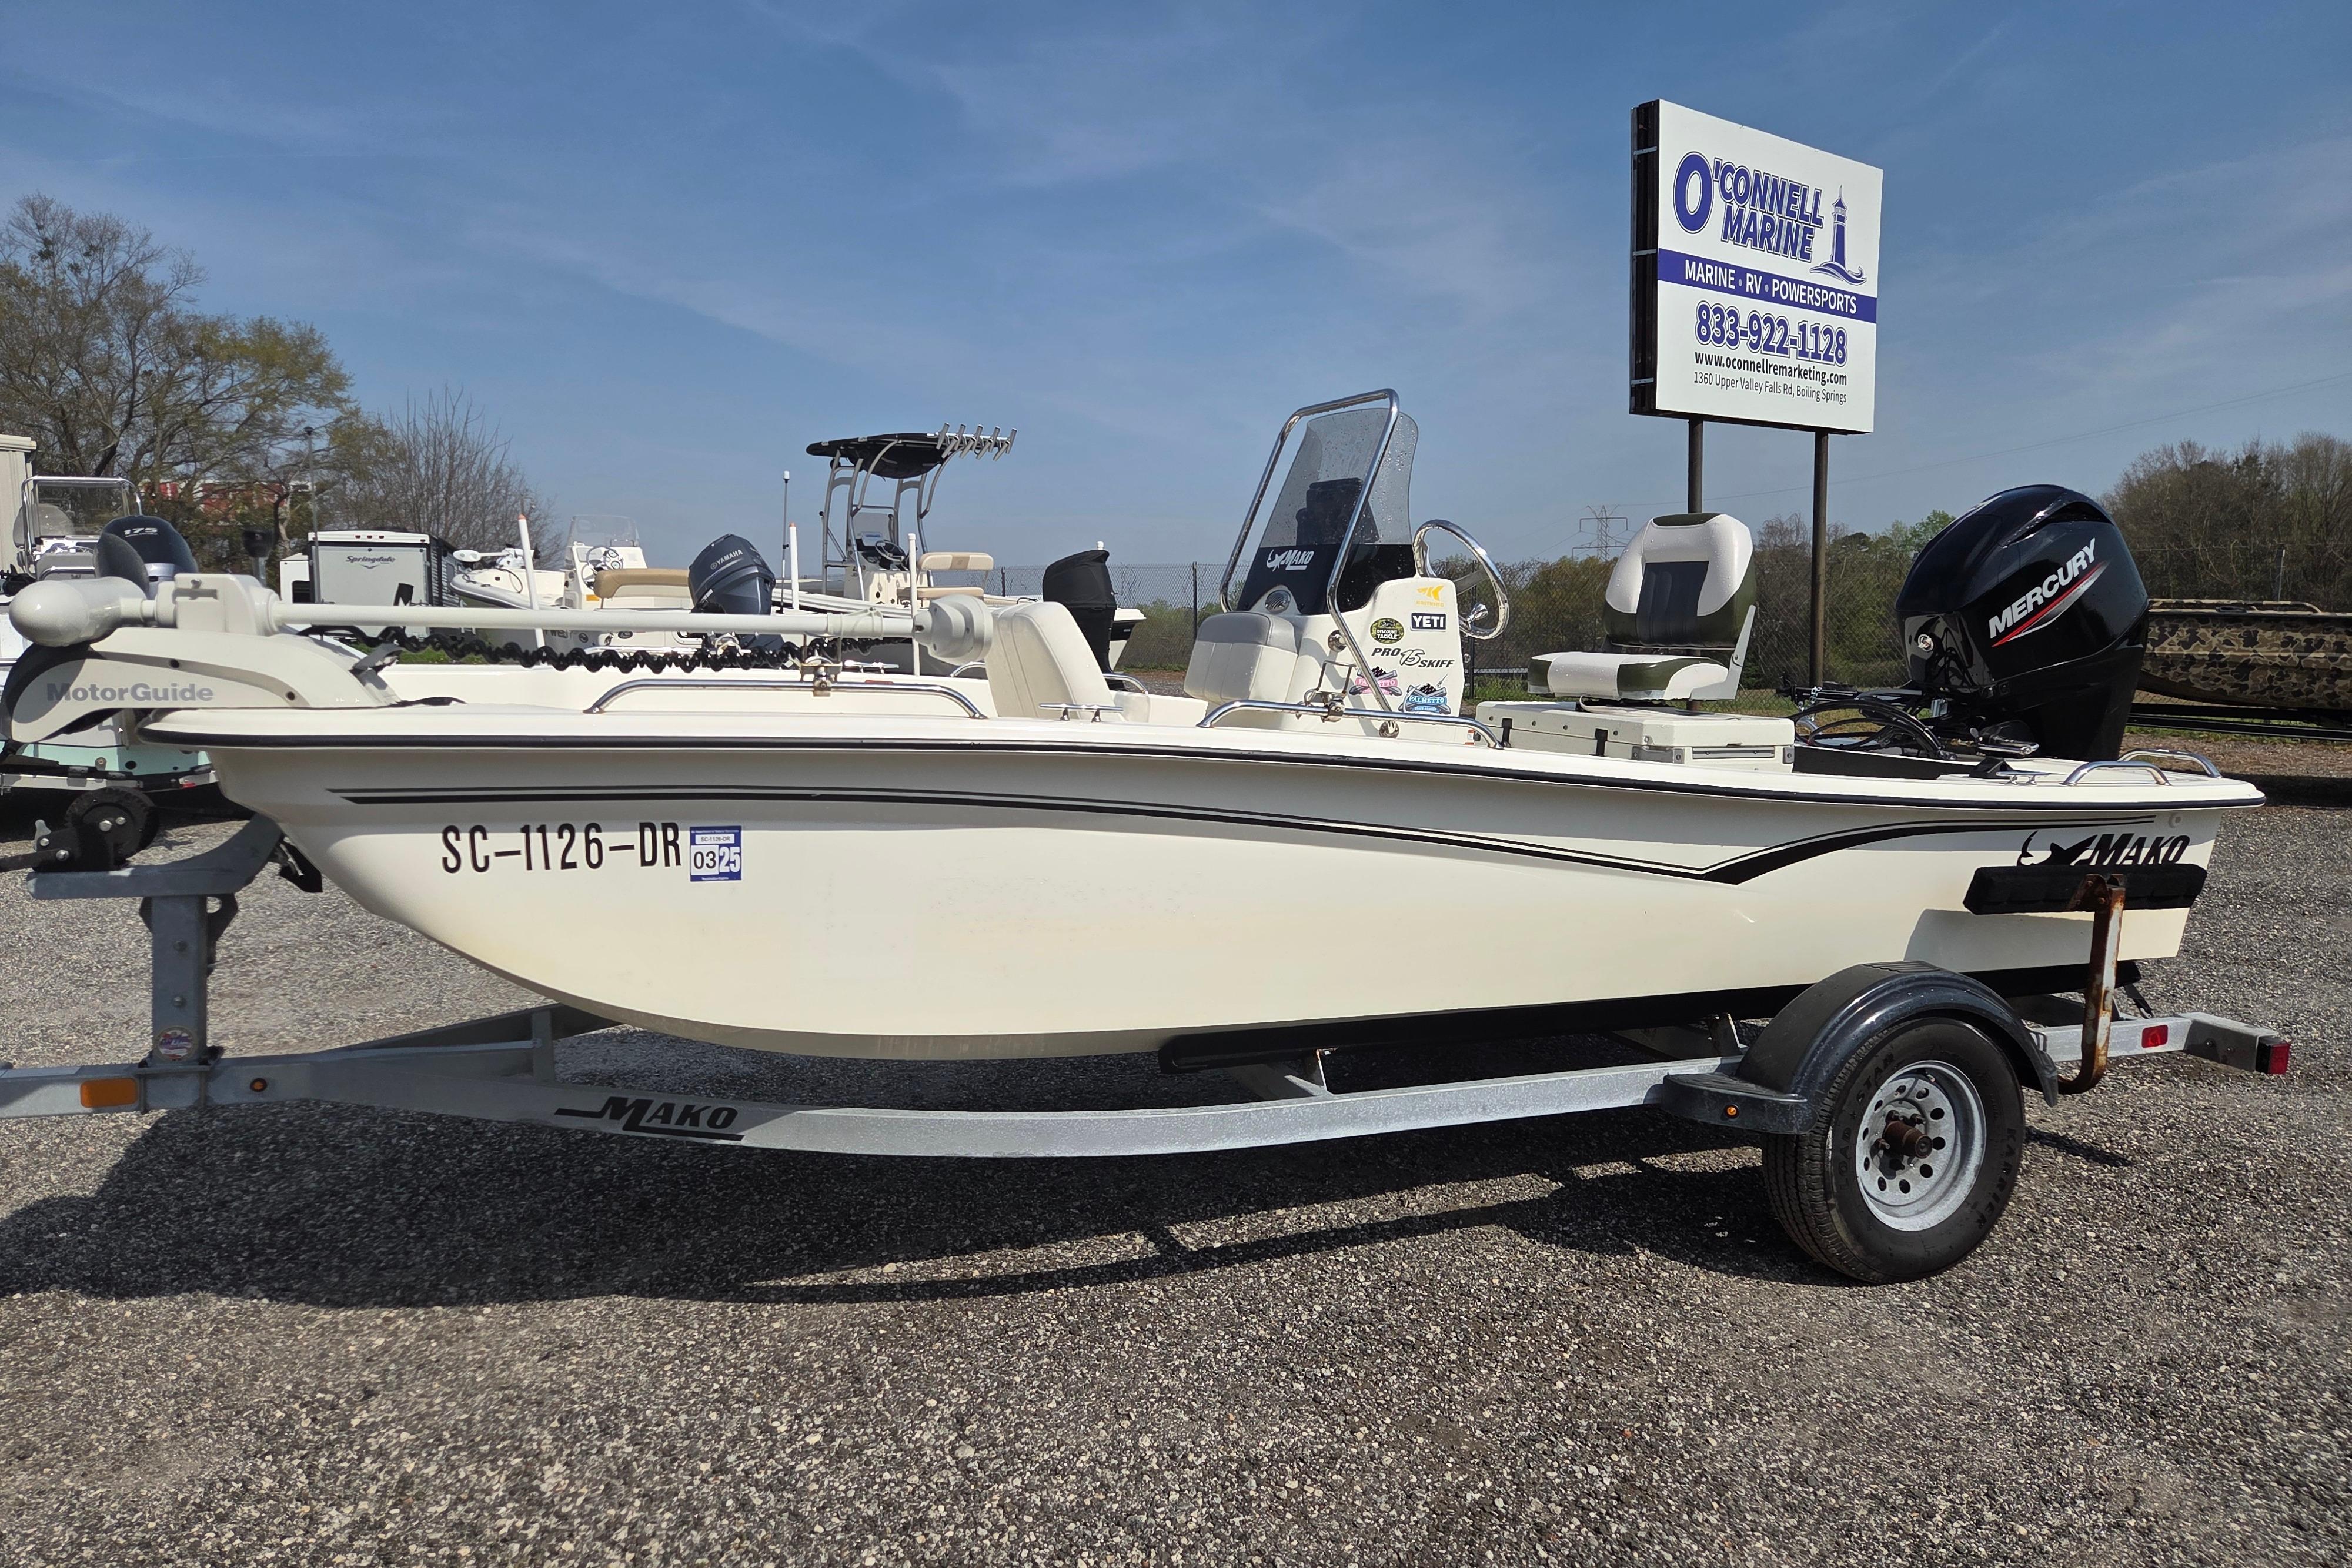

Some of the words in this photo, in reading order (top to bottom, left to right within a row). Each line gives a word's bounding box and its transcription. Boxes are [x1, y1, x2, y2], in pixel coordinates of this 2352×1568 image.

[1673, 152, 1824, 235] O'CONNELL
[1721, 203, 1815, 263] MARINE
[1685, 260, 1735, 289] MARINE
[1745, 273, 1762, 294] RV
[1772, 279, 1856, 314] POWERSPORTS
[1695, 300, 1847, 367] 833-922-1128
[1695, 352, 1847, 386] www.oconnellremarketing.com
[1694, 371, 1713, 385] 1360
[1715, 373, 1739, 390] Upper
[1740, 377, 1763, 394] Valley
[1765, 380, 1782, 394] Falls
[1783, 383, 1795, 398] Rd,
[1797, 385, 1820, 402] Boiling
[1822, 388, 1847, 405] Springs
[716, 549, 743, 565] YAMAHA
[1281, 550, 1314, 570] MAKO
[1989, 537, 2095, 638] MERCURY
[1412, 615, 1444, 628] YETI
[1371, 648, 1401, 656] PRO
[1399, 649, 1425, 666] 15
[1418, 660, 1455, 668] SKIFF
[47, 683, 213, 701] MotorGuide
[442, 822, 681, 873] SC-1126-DR
[694, 851, 716, 869] 03
[719, 847, 740, 872] 25
[2077, 833, 2190, 865] MAKO
[599, 1096, 744, 1141] MAKO
